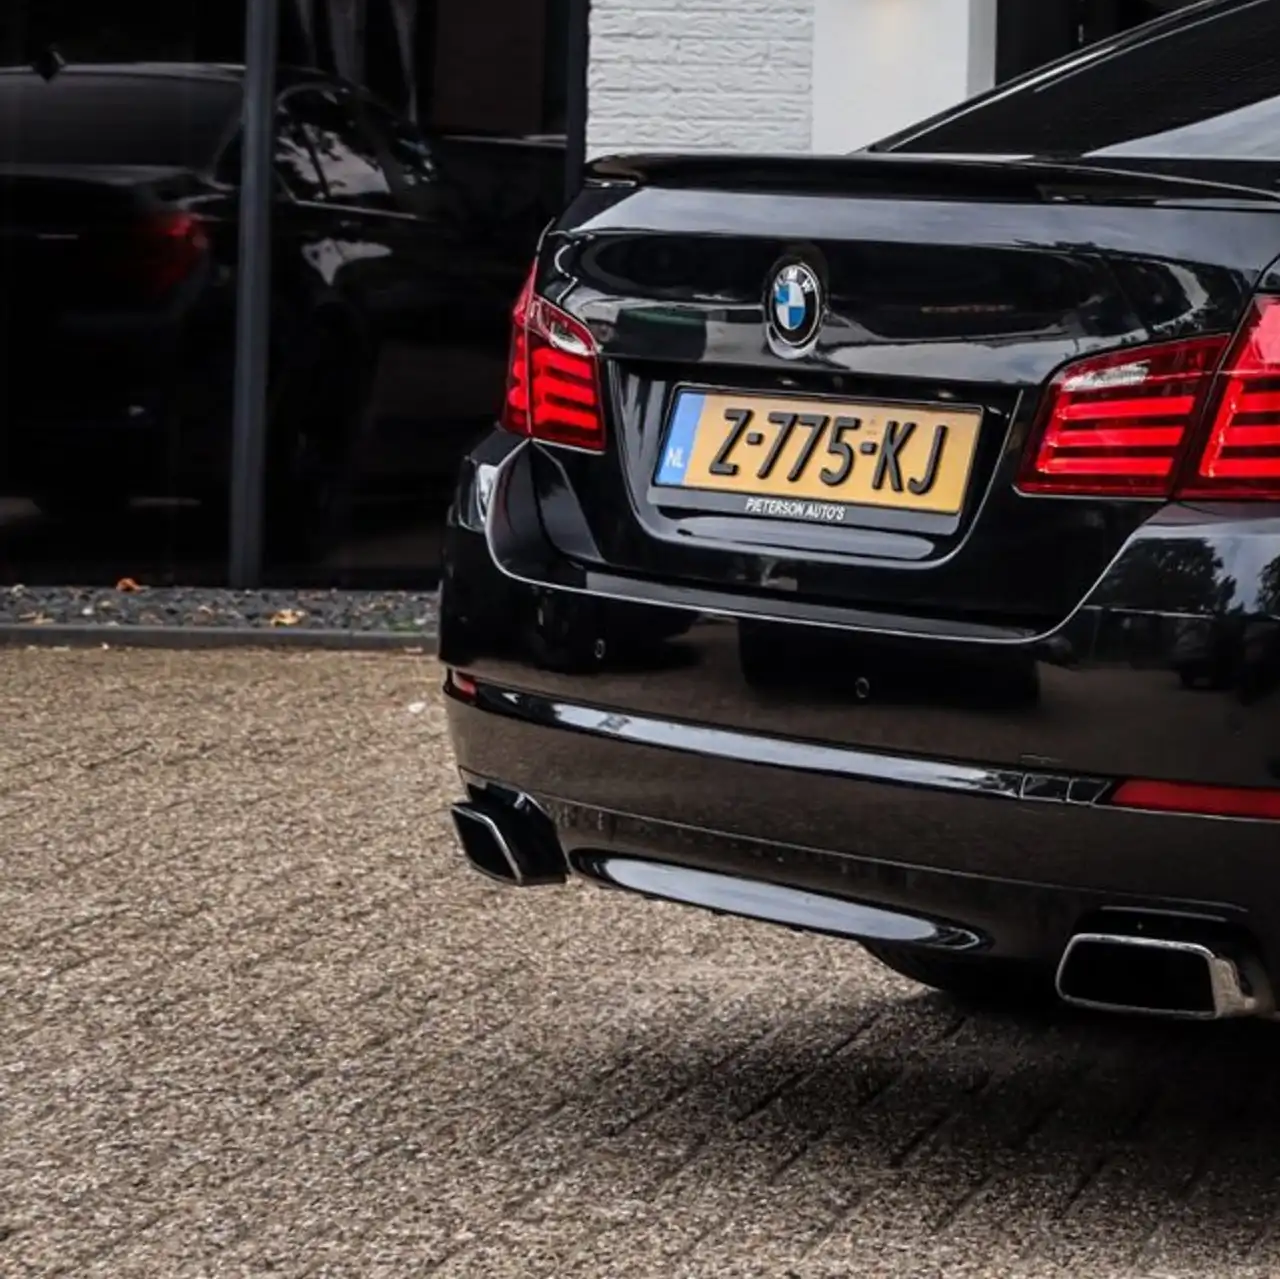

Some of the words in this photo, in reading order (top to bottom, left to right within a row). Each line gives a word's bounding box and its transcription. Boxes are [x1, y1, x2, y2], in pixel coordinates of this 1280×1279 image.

[665, 448, 685, 468] NL
[709, 409, 948, 494] Z-775-KJ
[745, 497, 804, 516] PIETERSON
